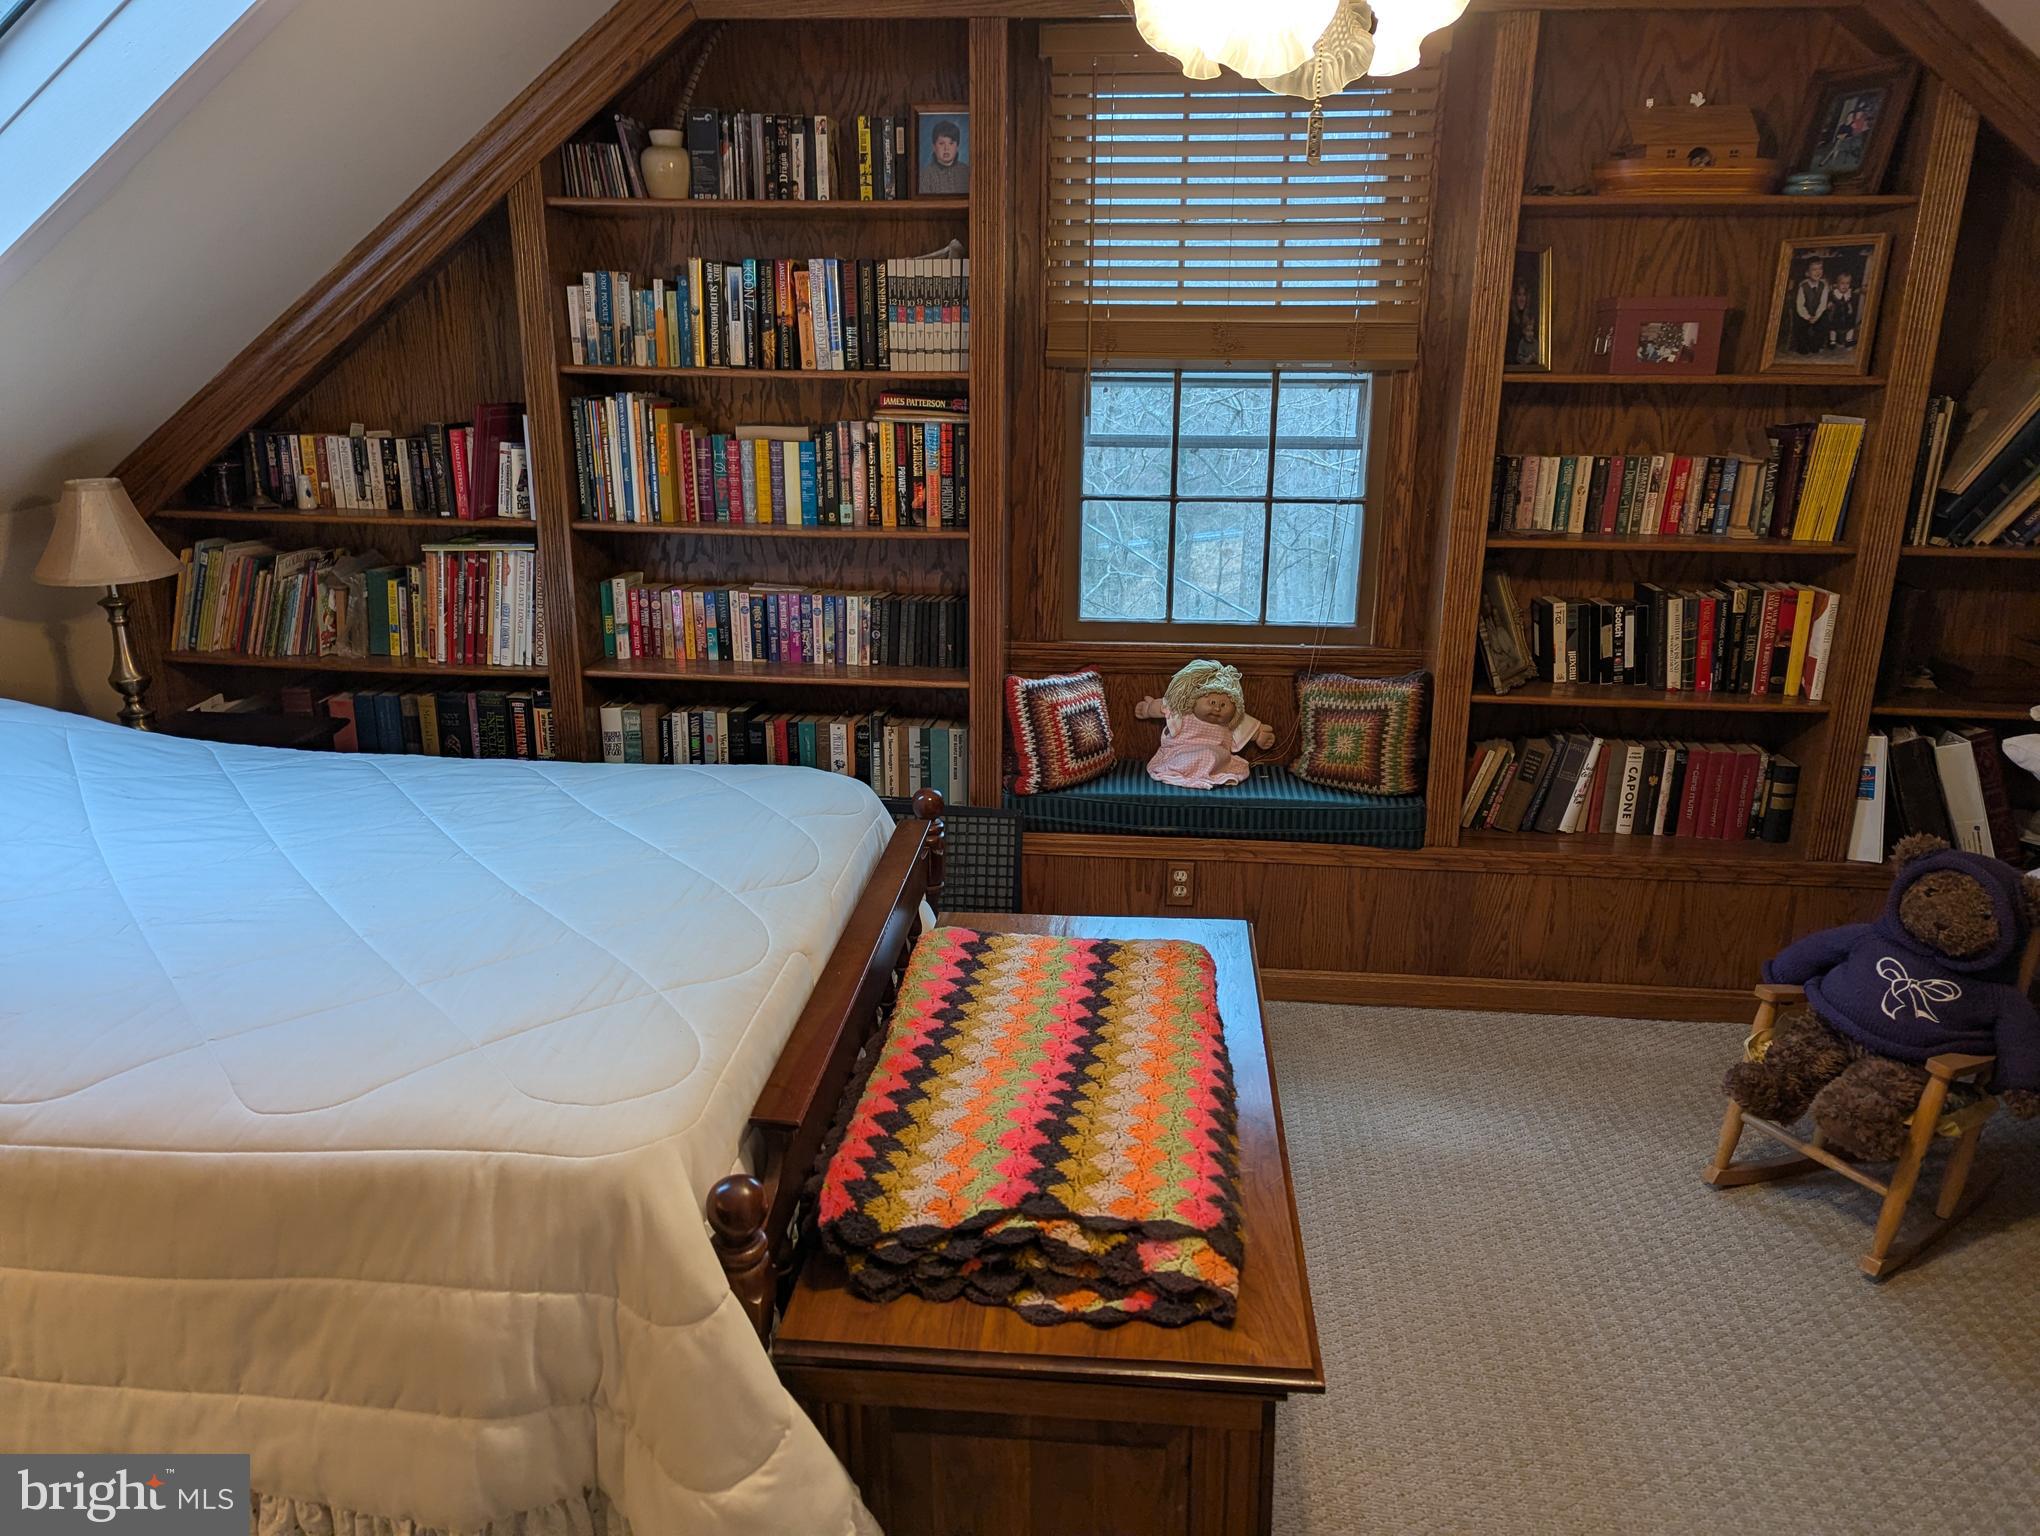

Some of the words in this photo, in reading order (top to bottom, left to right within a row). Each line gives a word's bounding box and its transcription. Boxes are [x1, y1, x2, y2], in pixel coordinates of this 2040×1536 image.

[599, 273, 607, 290] JODI
[744, 266, 755, 311] KOONTZ
[878, 288, 887, 320] SHELDON
[883, 396, 905, 405] JAMES
[906, 398, 946, 408] PATTERSON
[573, 421, 582, 450] FURNITURE
[868, 442, 876, 465] JAMES
[869, 466, 878, 507] PATTERSON
[897, 466, 908, 494] PRIVATE
[1765, 462, 1779, 495] MARY
[941, 486, 954, 519] PATTERSON
[517, 608, 525, 634] LONGER
[536, 609, 545, 658] COOKBOOK
[1614, 606, 1625, 638] Scotch
[1568, 650, 1577, 681] maxell
[1622, 767, 1638, 819] CAPONE
